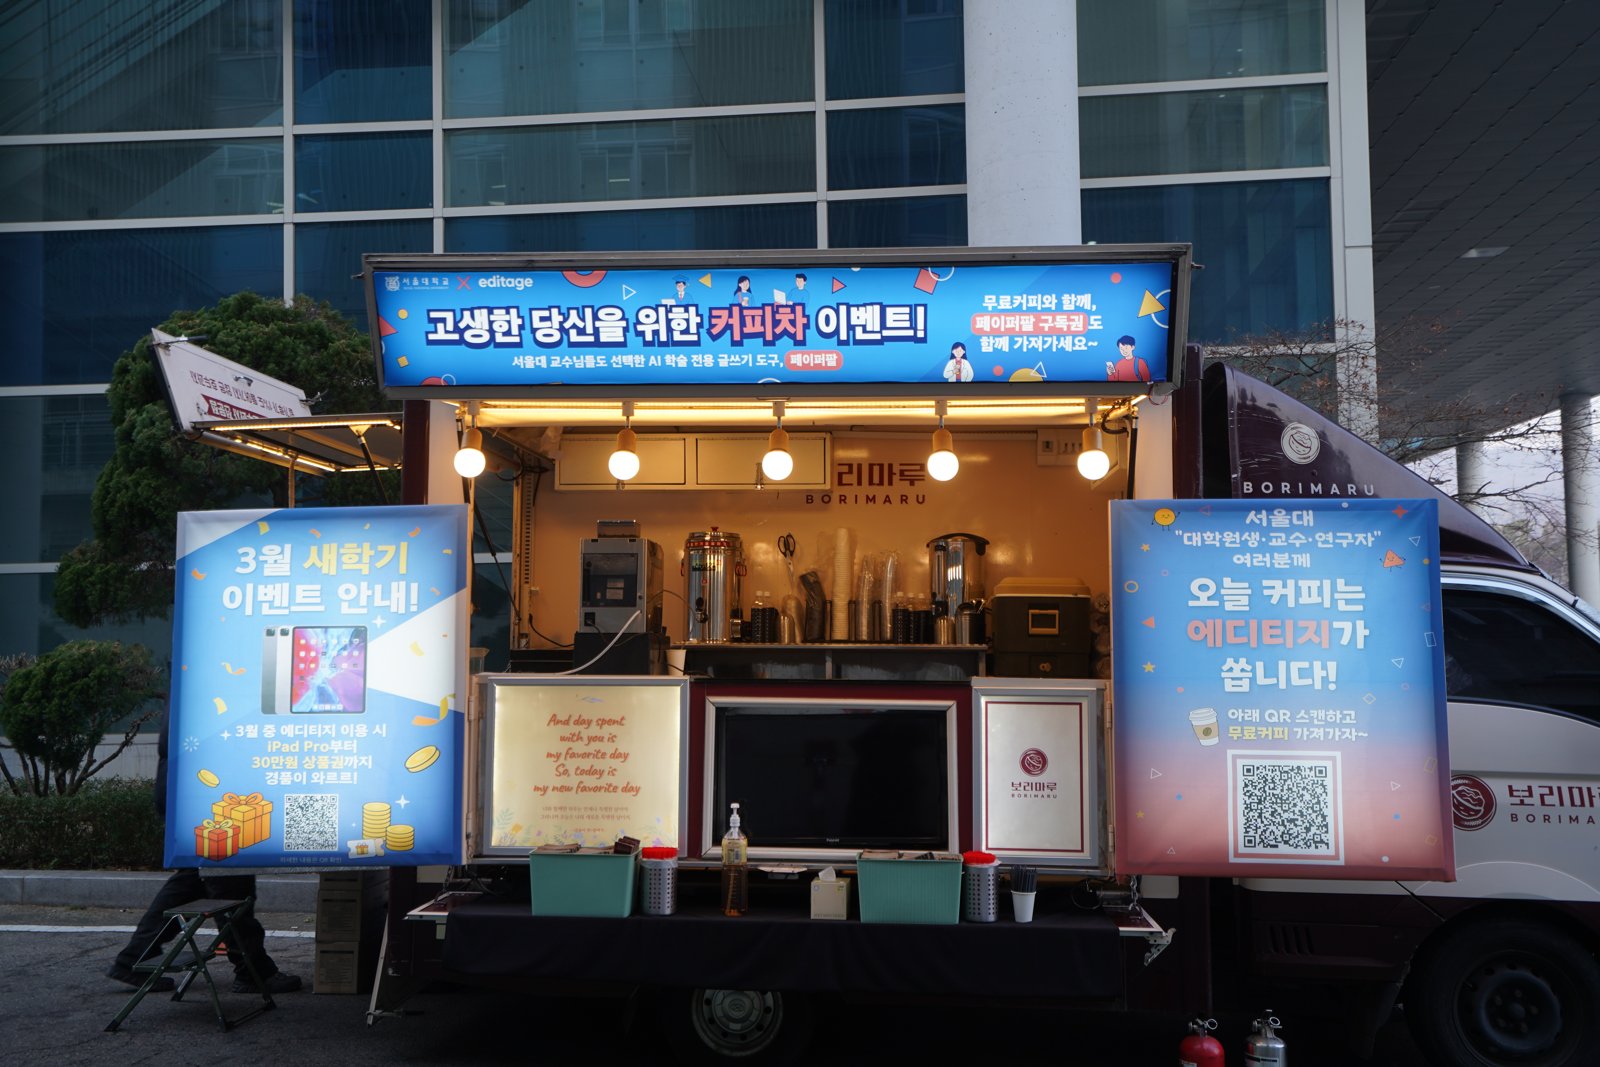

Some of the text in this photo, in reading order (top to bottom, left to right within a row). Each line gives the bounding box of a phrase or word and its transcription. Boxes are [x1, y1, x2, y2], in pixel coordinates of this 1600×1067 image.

[402, 277, 449, 286] 서울대학교
[478, 275, 533, 290] editage
[983, 293, 1097, 311] 무료커피와 함께,
[426, 303, 926, 346] 고생한 당신을 위한 커피차 이벤트!
[976, 315, 1103, 331] 페이퍼팔 구독권 도
[980, 336, 1098, 352] 함께 가져가세요~
[512, 354, 784, 368] 서울대 교수님들도 선택한 AI 학술 전용 글쓰기 도구,
[790, 353, 837, 367] 페이퍼팔
[837, 463, 926, 487] 리마루
[1243, 481, 1375, 496] BORIMARU
[805, 494, 926, 505] BORIMARU
[1246, 508, 1314, 528] 서울대
[235, 542, 409, 576] 3월 새학기
[1232, 552, 1311, 569] 여러분께
[222, 580, 419, 616] 이벤트 안내!
[1188, 576, 1366, 612] 오늘 커피는
[1186, 618, 1370, 649] 에디티지가
[1221, 657, 1337, 692] 쏩니다!
[547, 713, 625, 730] And day spent
[1227, 708, 1357, 725] 아래 QR 스캔하고
[235, 723, 387, 738] 3월 중 에디티지 이용 시
[560, 731, 617, 746] with you is
[1228, 725, 1368, 742] 무료커피 가져가자~
[267, 740, 357, 753] iPad Pro부터
[252, 755, 372, 769] 30만원 상품권까지
[546, 747, 629, 763] my favorite day
[265, 771, 306, 785] 경품이
[555, 763, 617, 779] So, today is
[533, 781, 641, 797] my new favorite day
[1011, 782, 1057, 791] 보리마루
[1507, 785, 1600, 808] 보리마
[1510, 812, 1596, 825] BORIMA
